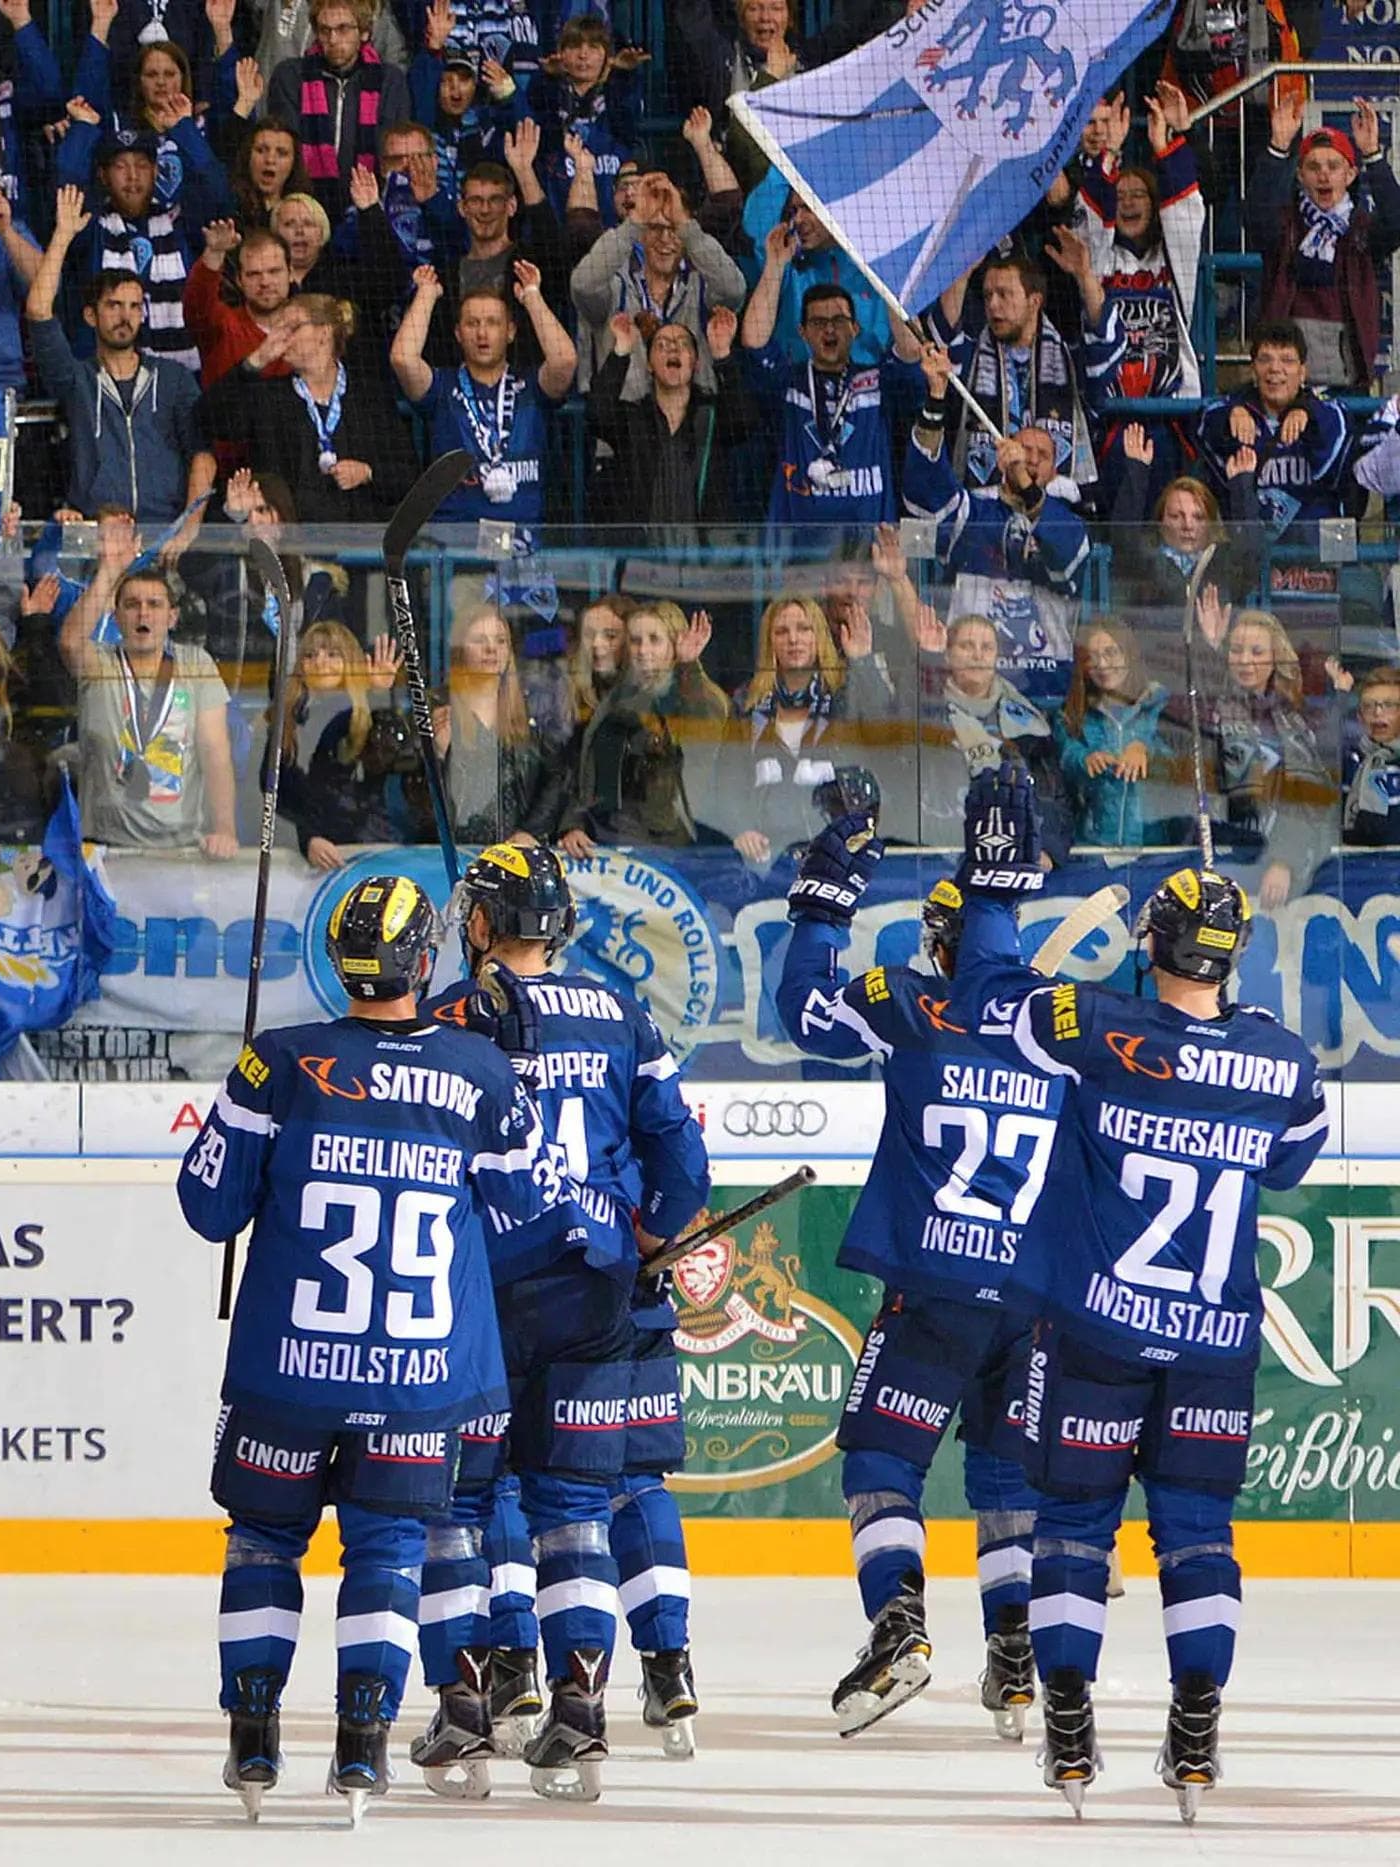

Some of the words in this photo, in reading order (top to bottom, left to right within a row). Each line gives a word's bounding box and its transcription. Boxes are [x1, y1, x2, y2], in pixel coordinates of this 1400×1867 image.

[370, 1062, 484, 1121] SATURN
[1176, 1044, 1299, 1098] SATURN
[310, 1133, 464, 1186] GREILINGER
[1098, 1102, 1274, 1168] KIEFERSAUER
[922, 1104, 1057, 1225] 27
[921, 1216, 1022, 1265] INGOLS
[1113, 1152, 1248, 1305] 21
[291, 1181, 458, 1339] 39
[1085, 1272, 1251, 1348] INGOLSTADT
[278, 1337, 450, 1385] INGOLSTADT
[554, 1399, 625, 1426] CINQUE
[876, 1384, 951, 1430] CINQUE
[1061, 1415, 1145, 1447] CINQUE
[1170, 1405, 1250, 1436] CINQUE
[234, 1435, 322, 1475] CINQUE
